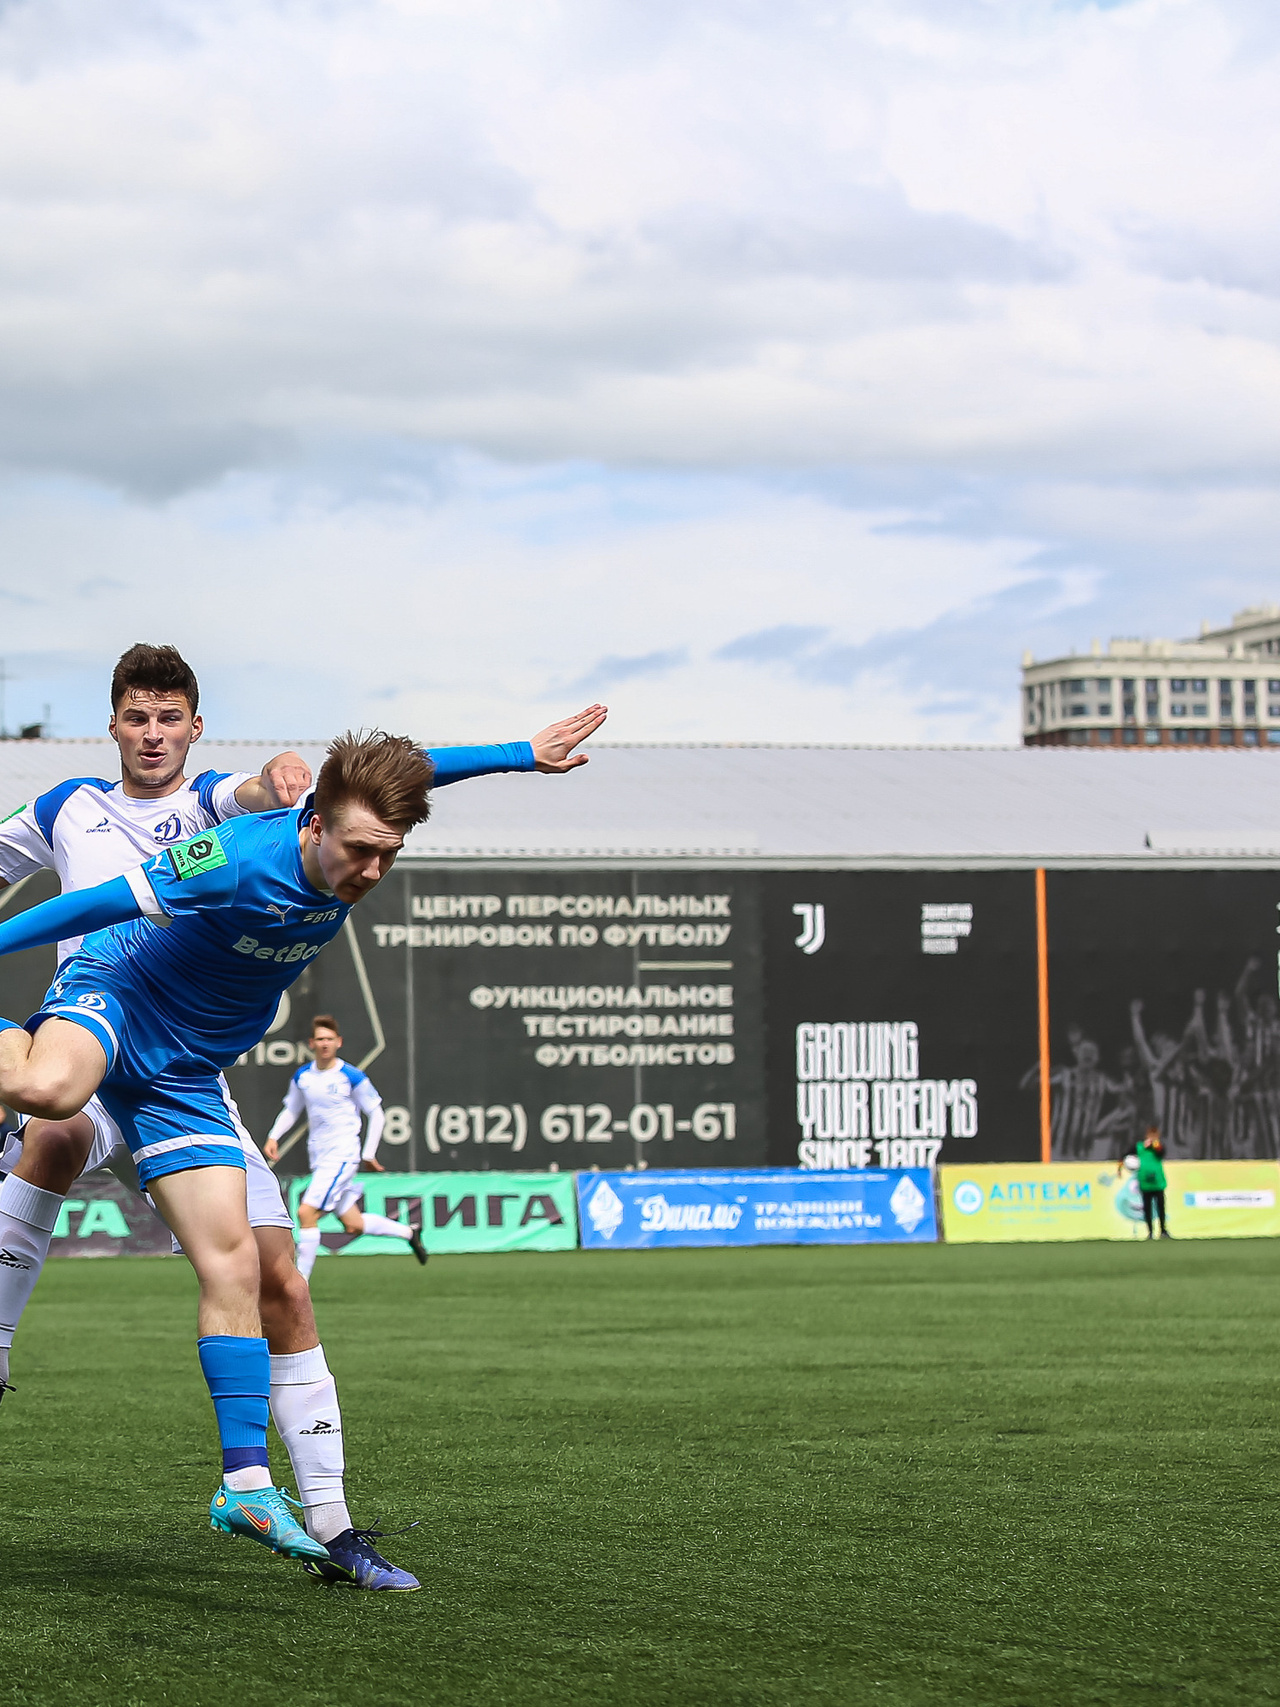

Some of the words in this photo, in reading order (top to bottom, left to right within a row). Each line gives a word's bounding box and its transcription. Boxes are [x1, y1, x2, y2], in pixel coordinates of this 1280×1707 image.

[192, 842, 208, 857] 2
[312, 907, 340, 924] ВТБ
[412, 896, 501, 919] ЦЕНТР
[506, 895, 732, 917] ПЕРСОНАЛЬНЫХ
[372, 925, 553, 947] ТРЕНИРОВОК
[558, 925, 599, 947] ПО
[602, 924, 732, 947] ФУТБОЛУ
[232, 935, 320, 962] BetBo
[470, 985, 734, 1011] ФУНКЦИОНАЛЬНОЕ
[523, 1015, 734, 1037] ТЕСТИРОВАНИЕ
[535, 1043, 735, 1067] ФУТБОЛИСТОВ
[797, 1022, 919, 1081] GROWING
[797, 1081, 870, 1139] YOUR
[872, 1079, 978, 1138] DREAMS
[383, 1106, 411, 1144] 8
[424, 1104, 527, 1152] (812)
[540, 1102, 735, 1144] 612-01-61
[989, 1181, 1091, 1200] АПТЕКИ
